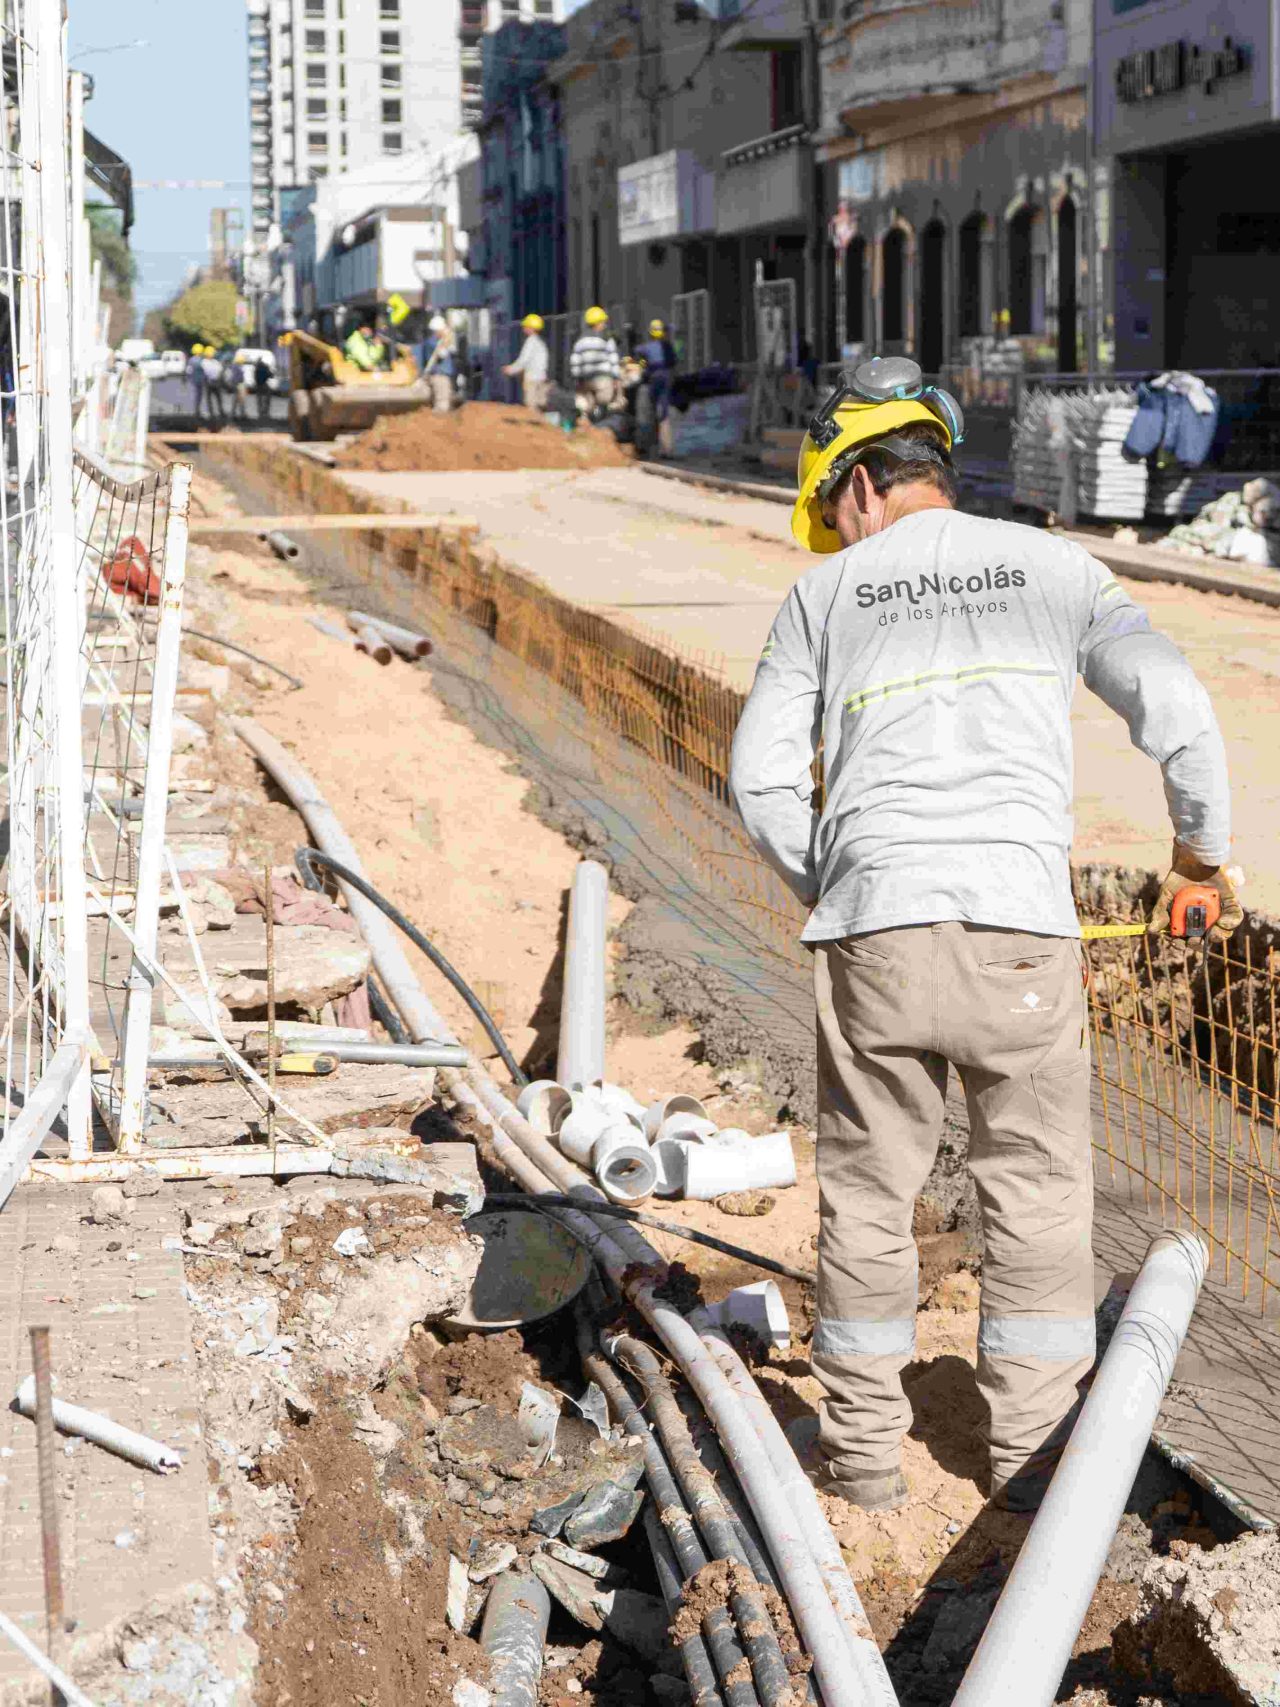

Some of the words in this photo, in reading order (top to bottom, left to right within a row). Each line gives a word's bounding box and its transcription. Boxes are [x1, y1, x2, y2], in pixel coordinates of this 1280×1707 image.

[855, 580, 920, 608] San
[916, 564, 1026, 597] Nicolás
[878, 610, 899, 626] de
[907, 607, 934, 621] los
[940, 601, 1008, 618] Arroyos
